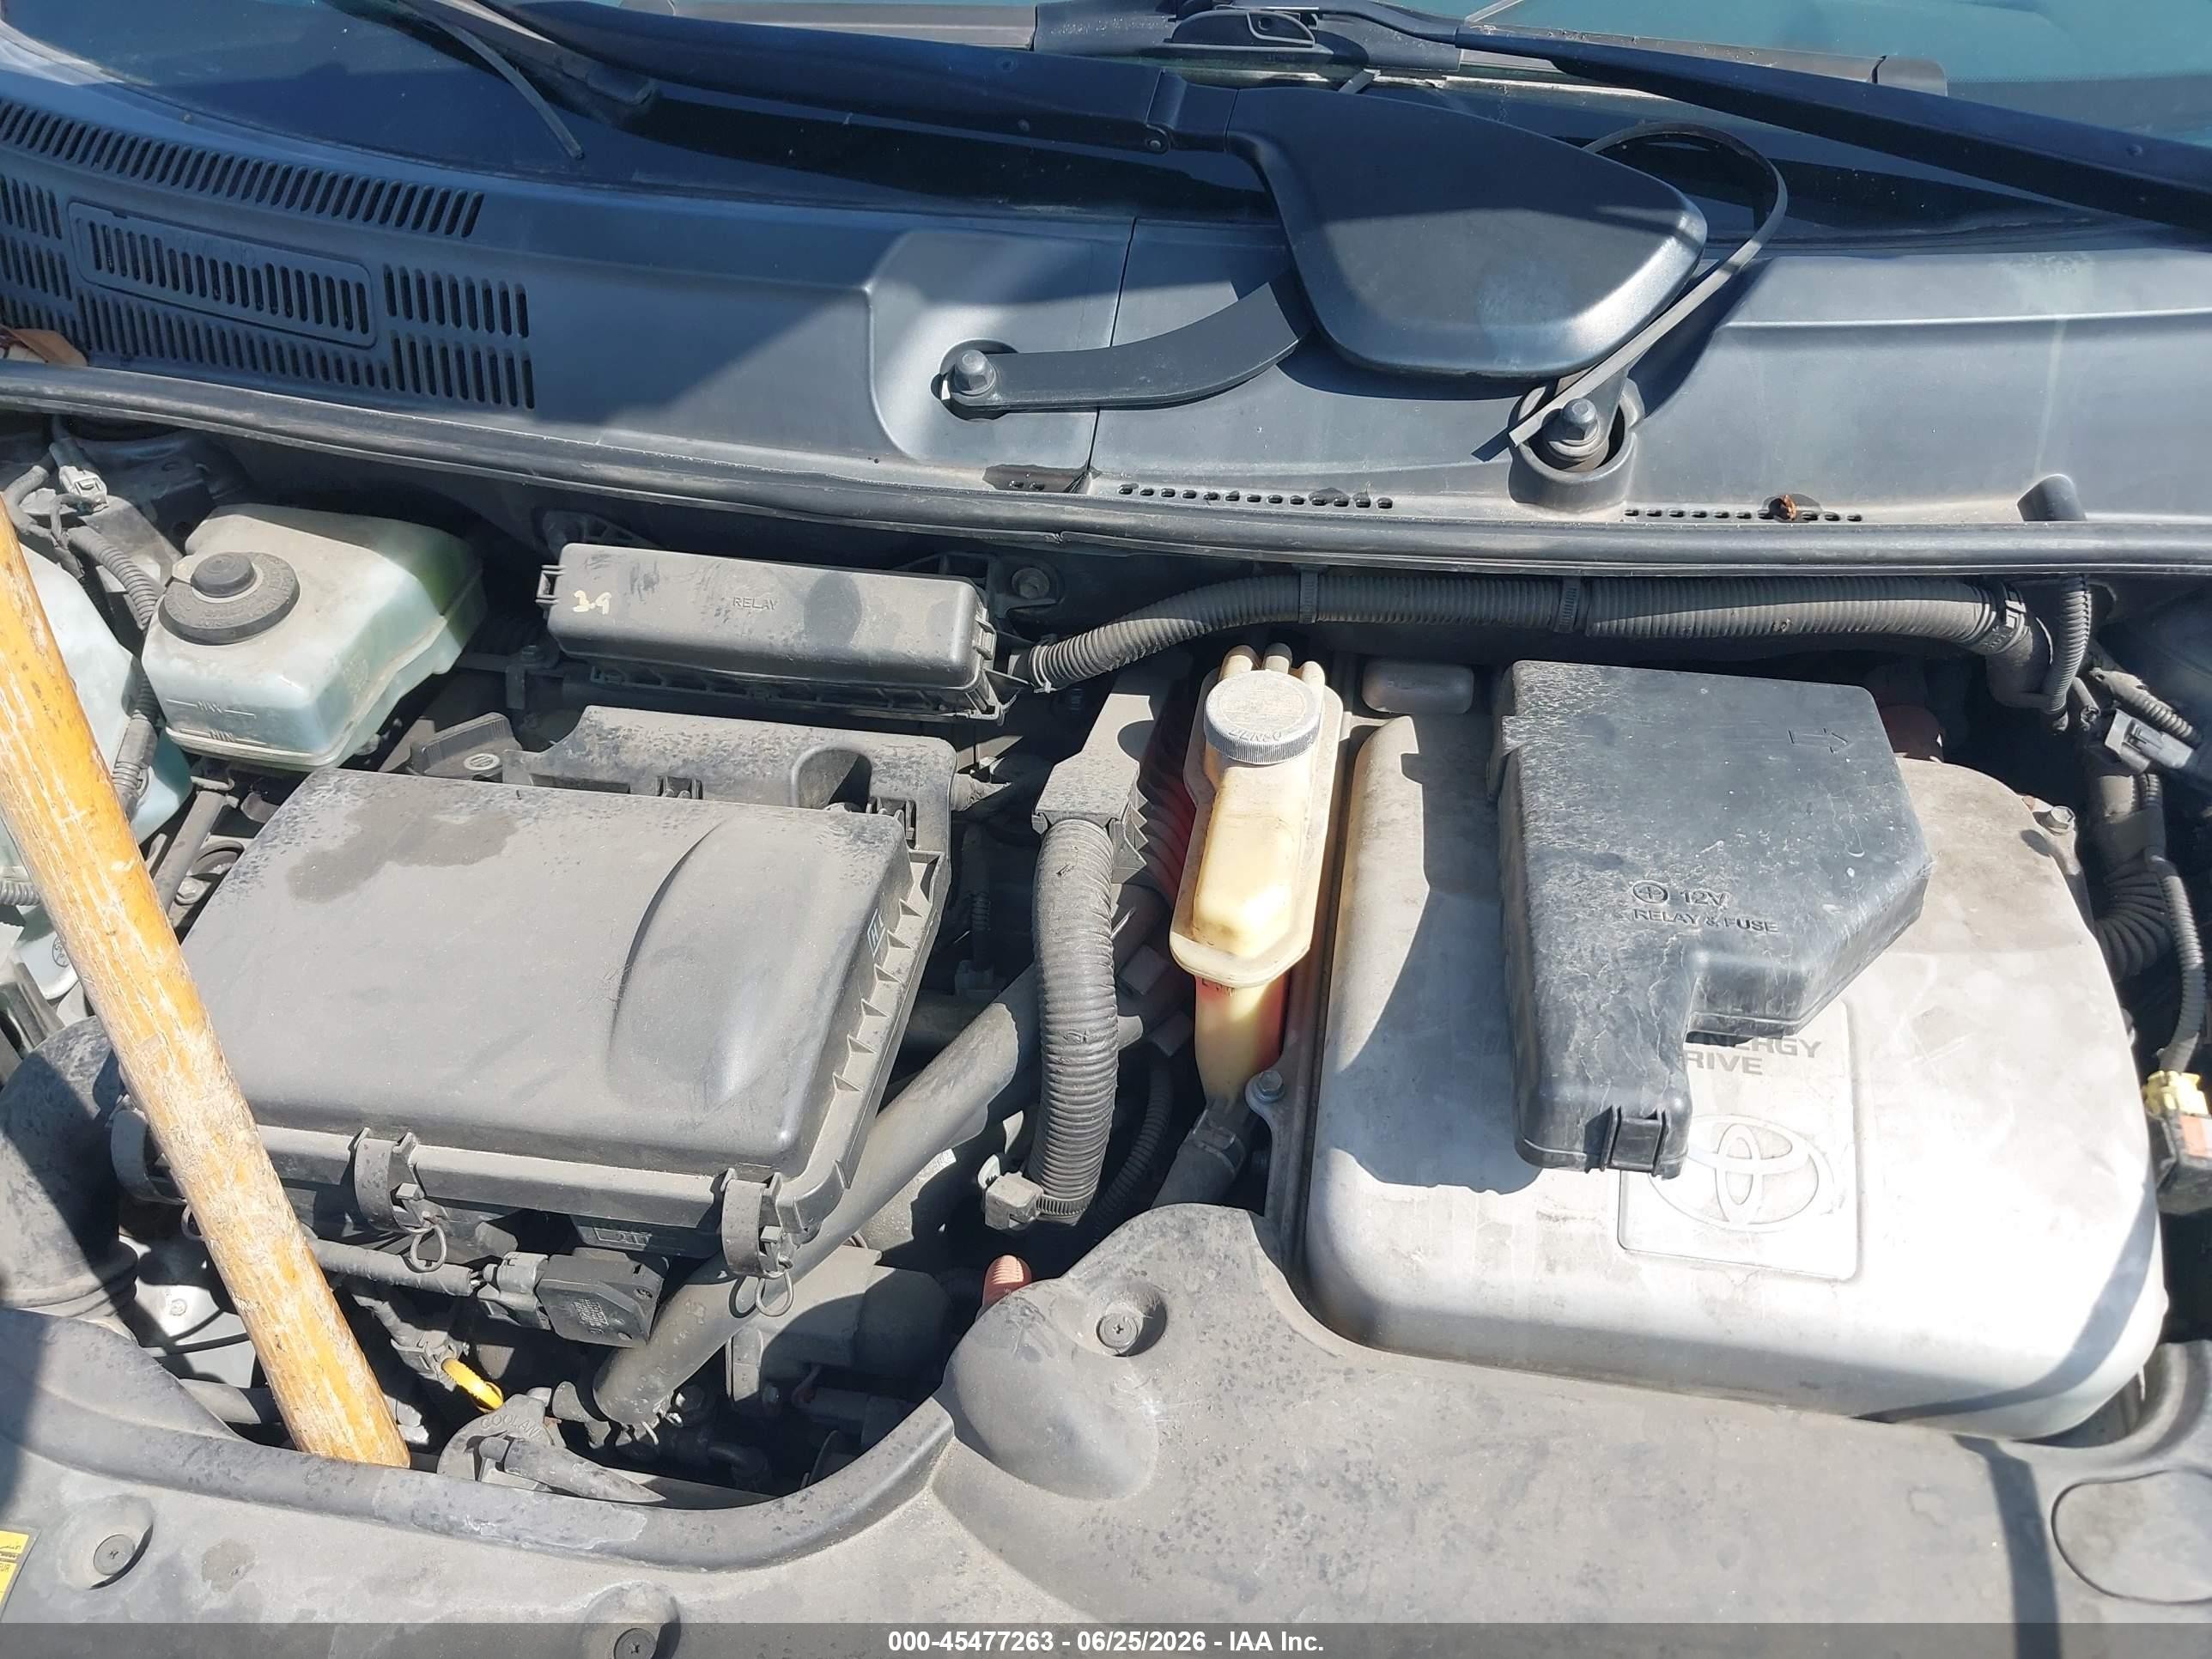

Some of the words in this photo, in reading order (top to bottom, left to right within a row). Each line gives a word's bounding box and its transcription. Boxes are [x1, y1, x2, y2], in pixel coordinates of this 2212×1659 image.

[732, 596, 777, 611] RELAY
[1680, 890, 1729, 907] 12V
[1632, 908, 1698, 925] RELAY
[1724, 916, 1779, 933] FUSE
[1686, 1049, 1764, 1076] RIVE
